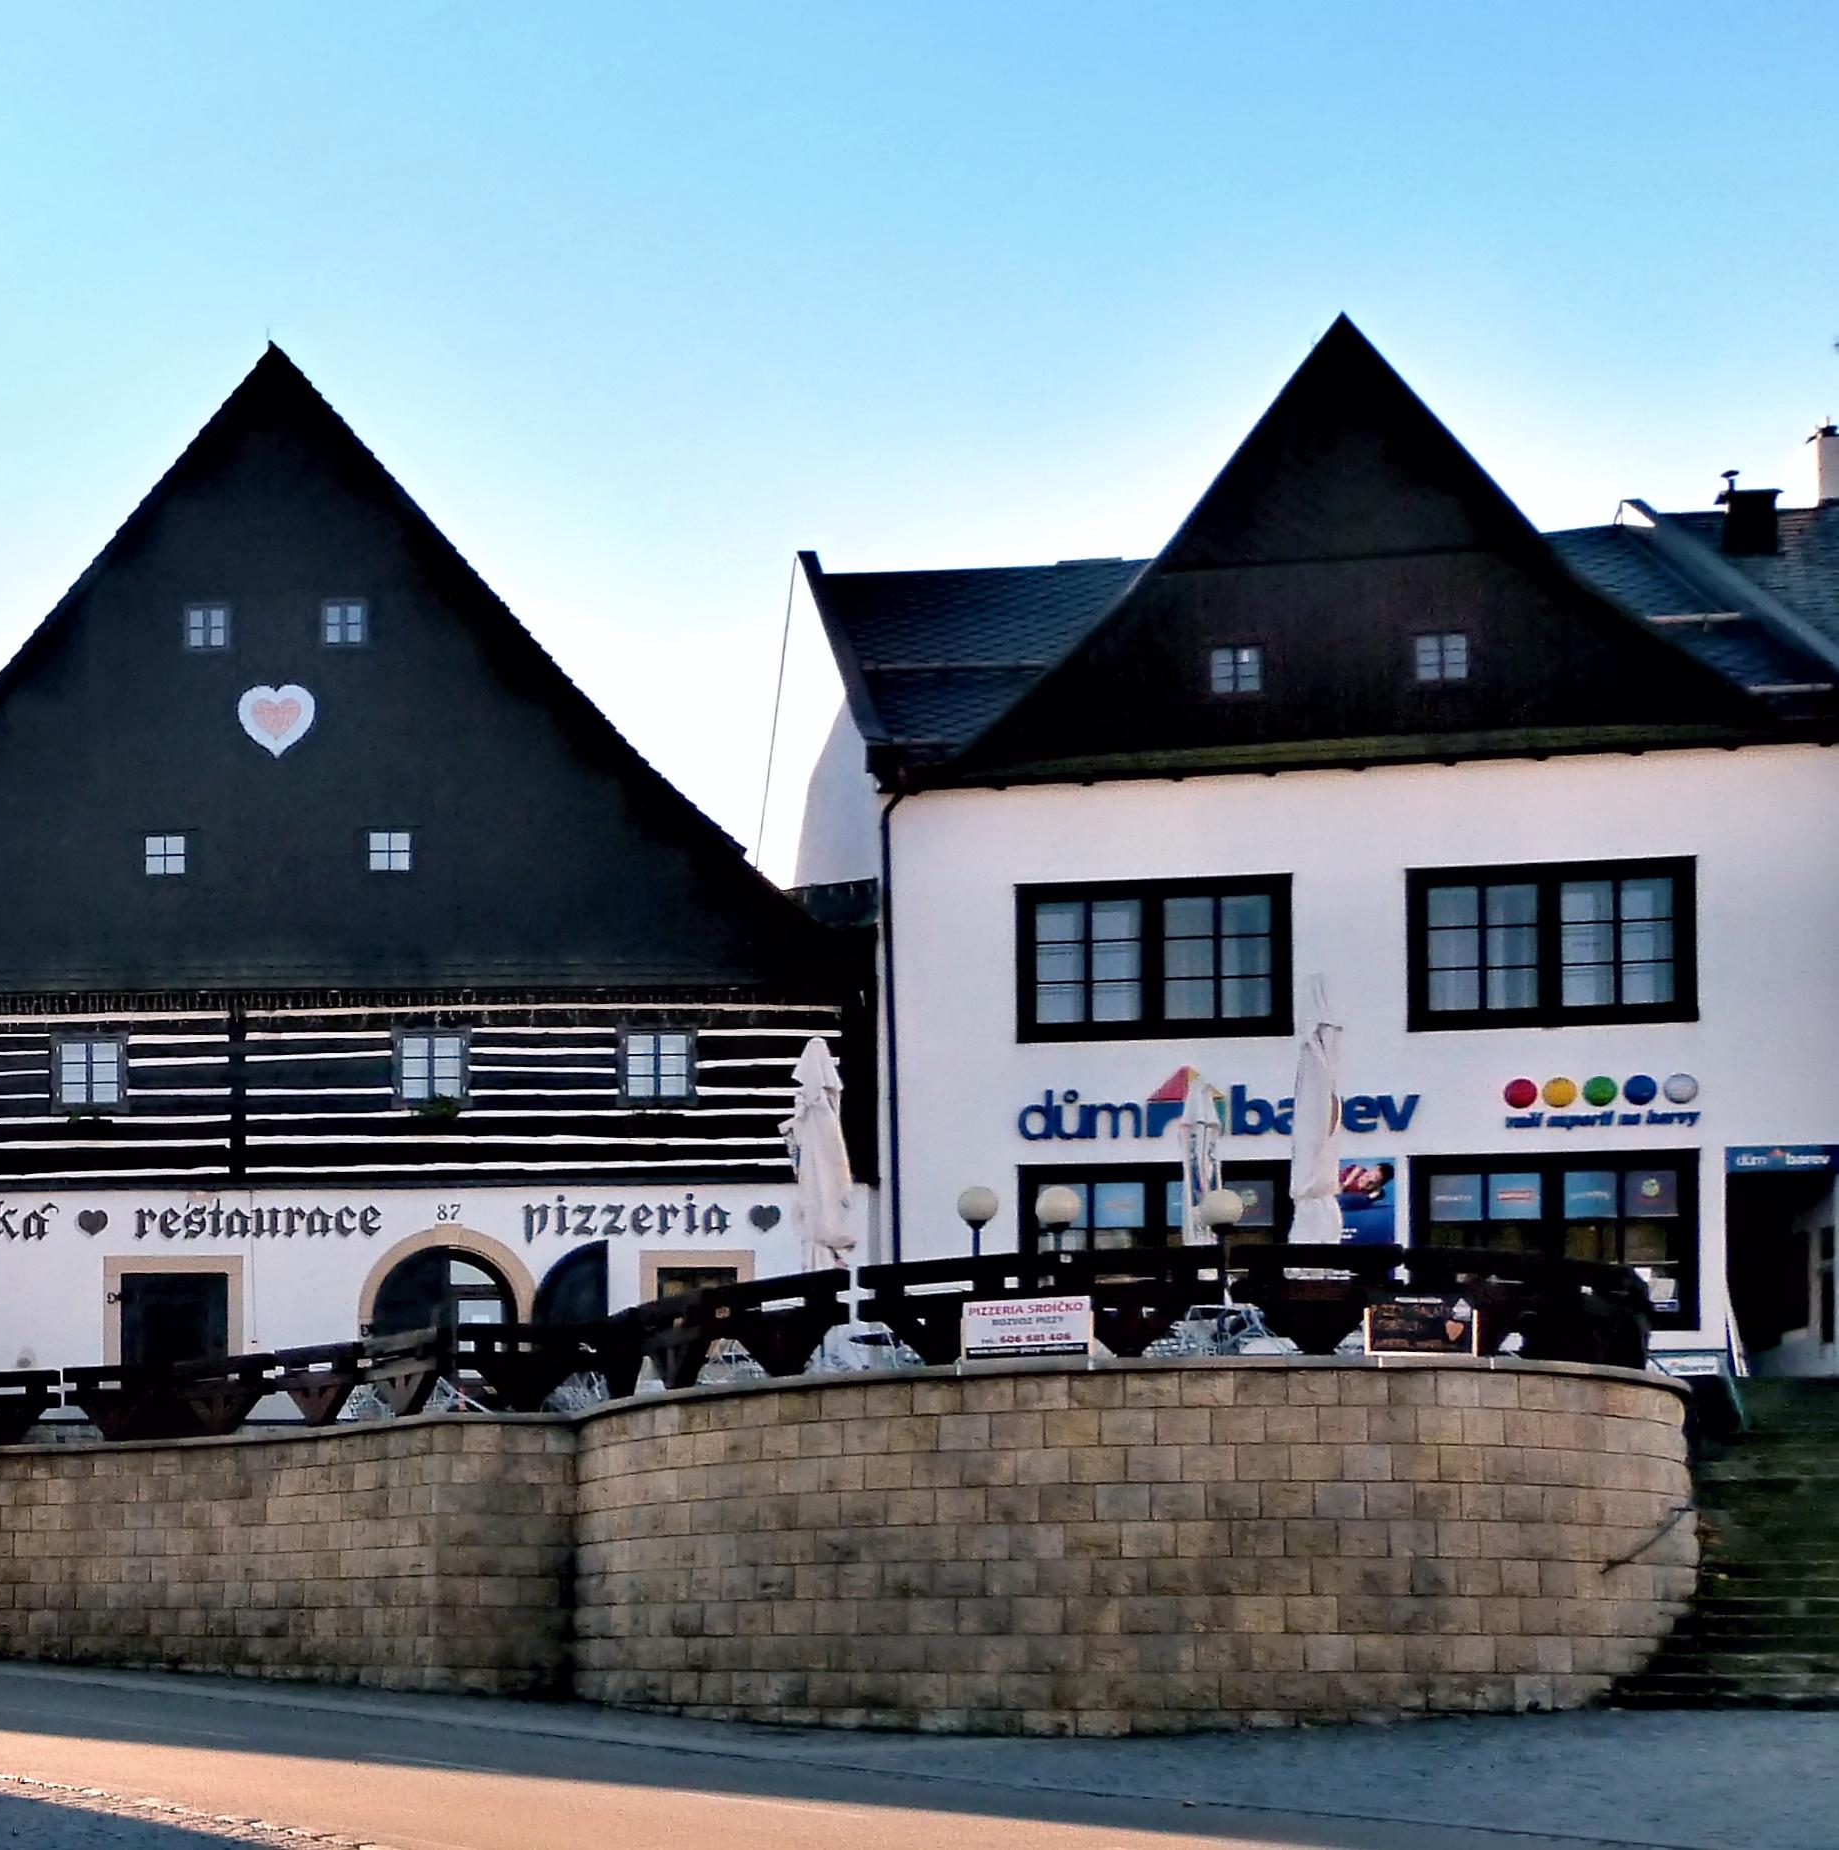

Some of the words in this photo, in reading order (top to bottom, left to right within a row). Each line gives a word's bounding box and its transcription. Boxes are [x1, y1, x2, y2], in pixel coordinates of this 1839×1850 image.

[1018, 1089, 1142, 1141] dům
[1230, 1084, 1421, 1137] baev
[134, 1198, 384, 1240] restaurace
[436, 1203, 461, 1221] 87
[522, 1194, 732, 1245] pizzeria
[968, 1305, 1024, 1316] PIZZERIA
